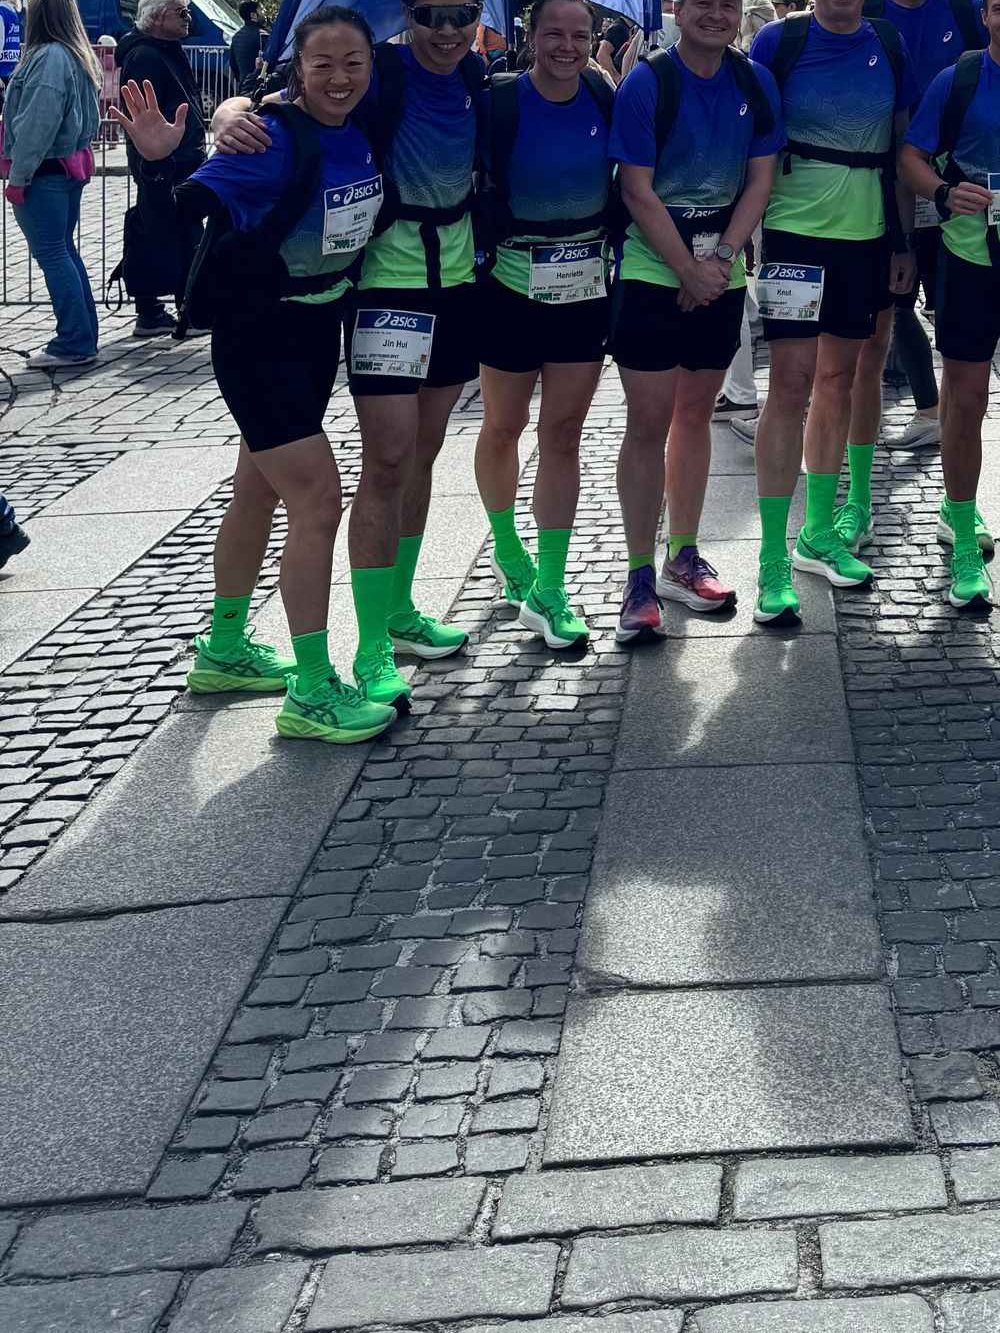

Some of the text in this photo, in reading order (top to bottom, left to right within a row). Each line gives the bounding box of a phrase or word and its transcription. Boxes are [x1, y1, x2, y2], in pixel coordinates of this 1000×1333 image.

[556, 270, 584, 280] Henriette
[583, 287, 600, 298] XXL
[776, 289, 792, 297] Knut
[382, 339, 408, 349] Jin Hui
[409, 363, 422, 376] XXL
